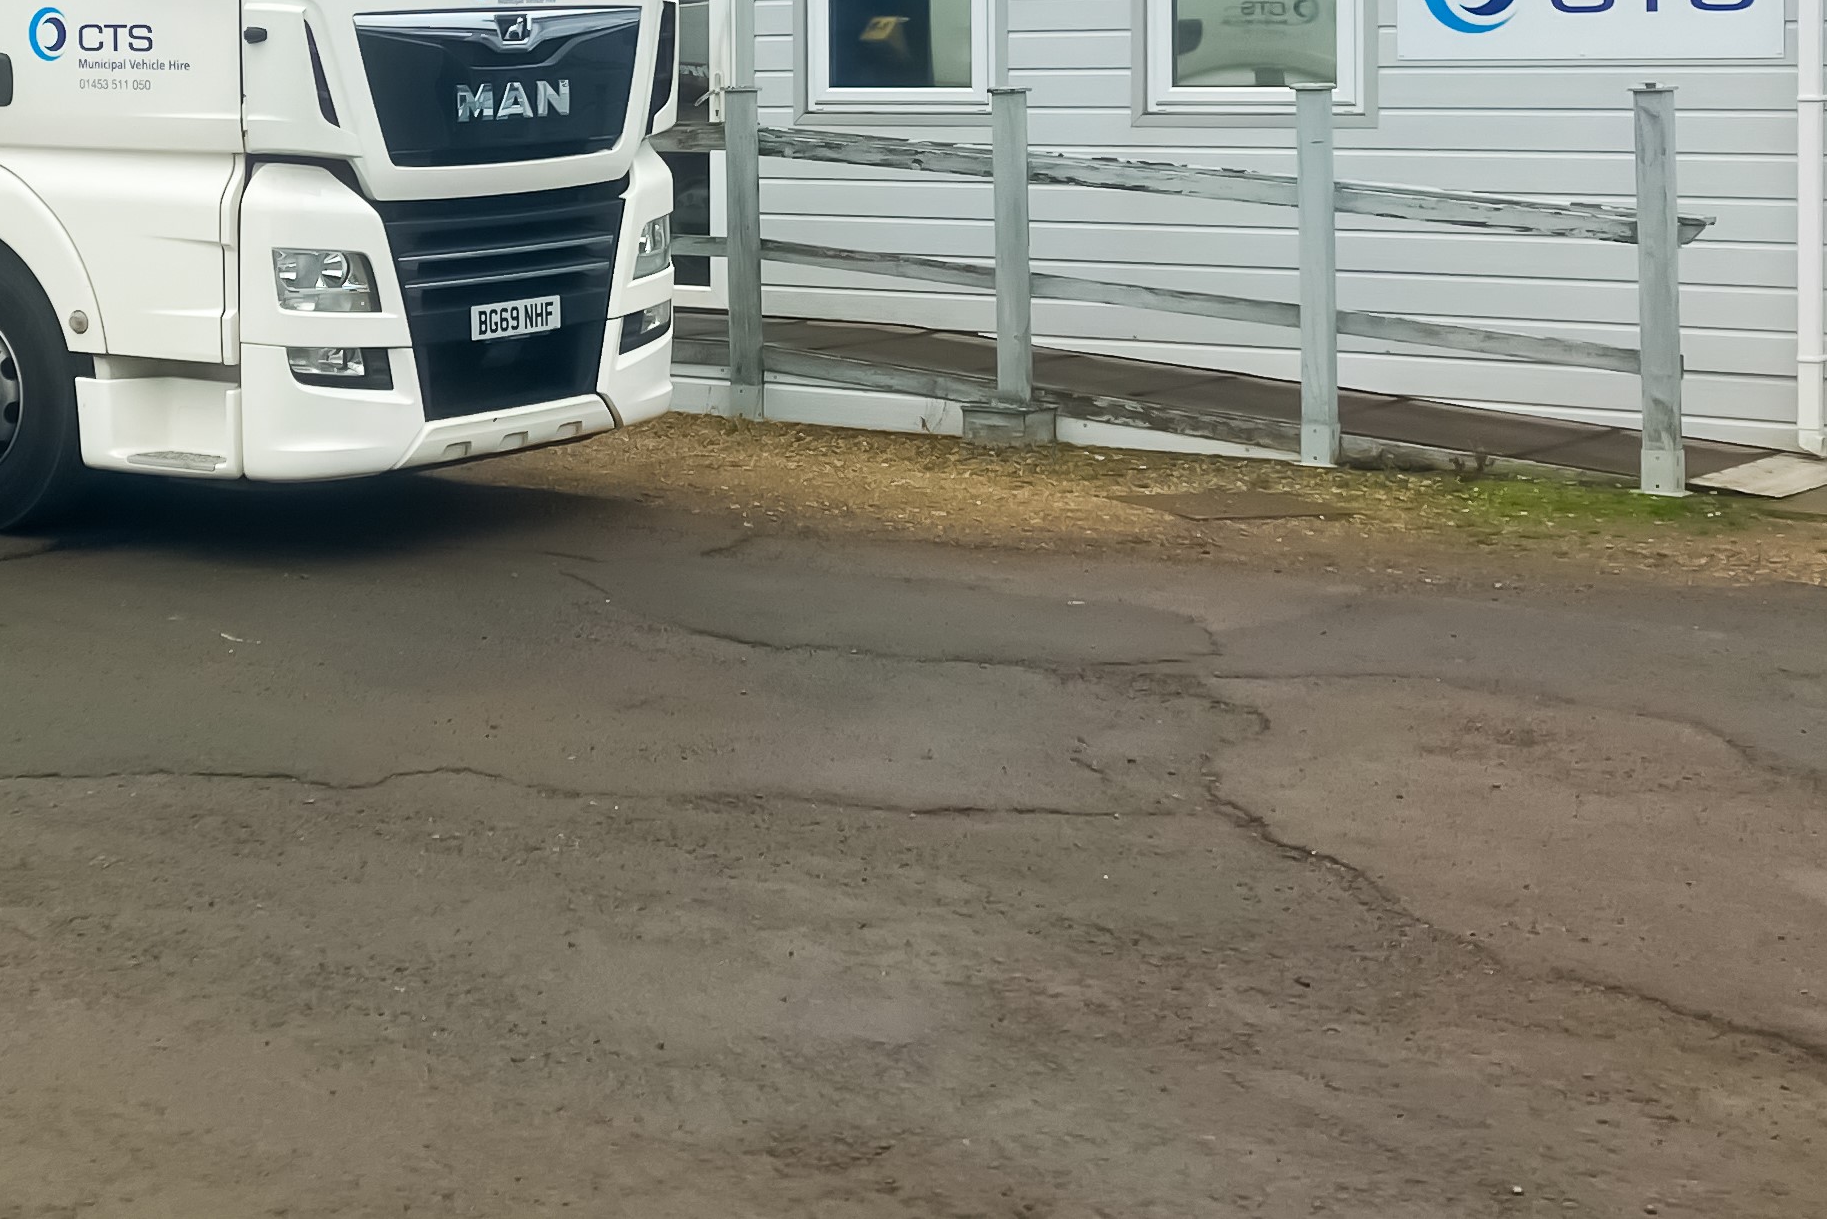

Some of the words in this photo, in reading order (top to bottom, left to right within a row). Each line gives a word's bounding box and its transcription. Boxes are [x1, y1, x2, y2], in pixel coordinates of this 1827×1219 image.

[78, 24, 153, 52] CTS
[78, 59, 126, 72] Municipal
[129, 59, 165, 70] Vehicle
[168, 60, 191, 71] Hire
[79, 79, 109, 90] 01453
[111, 79, 128, 90] 511
[132, 80, 151, 91] 050
[456, 79, 570, 122] MAN
[478, 306, 519, 335] BG69
[524, 301, 554, 329] NHF
